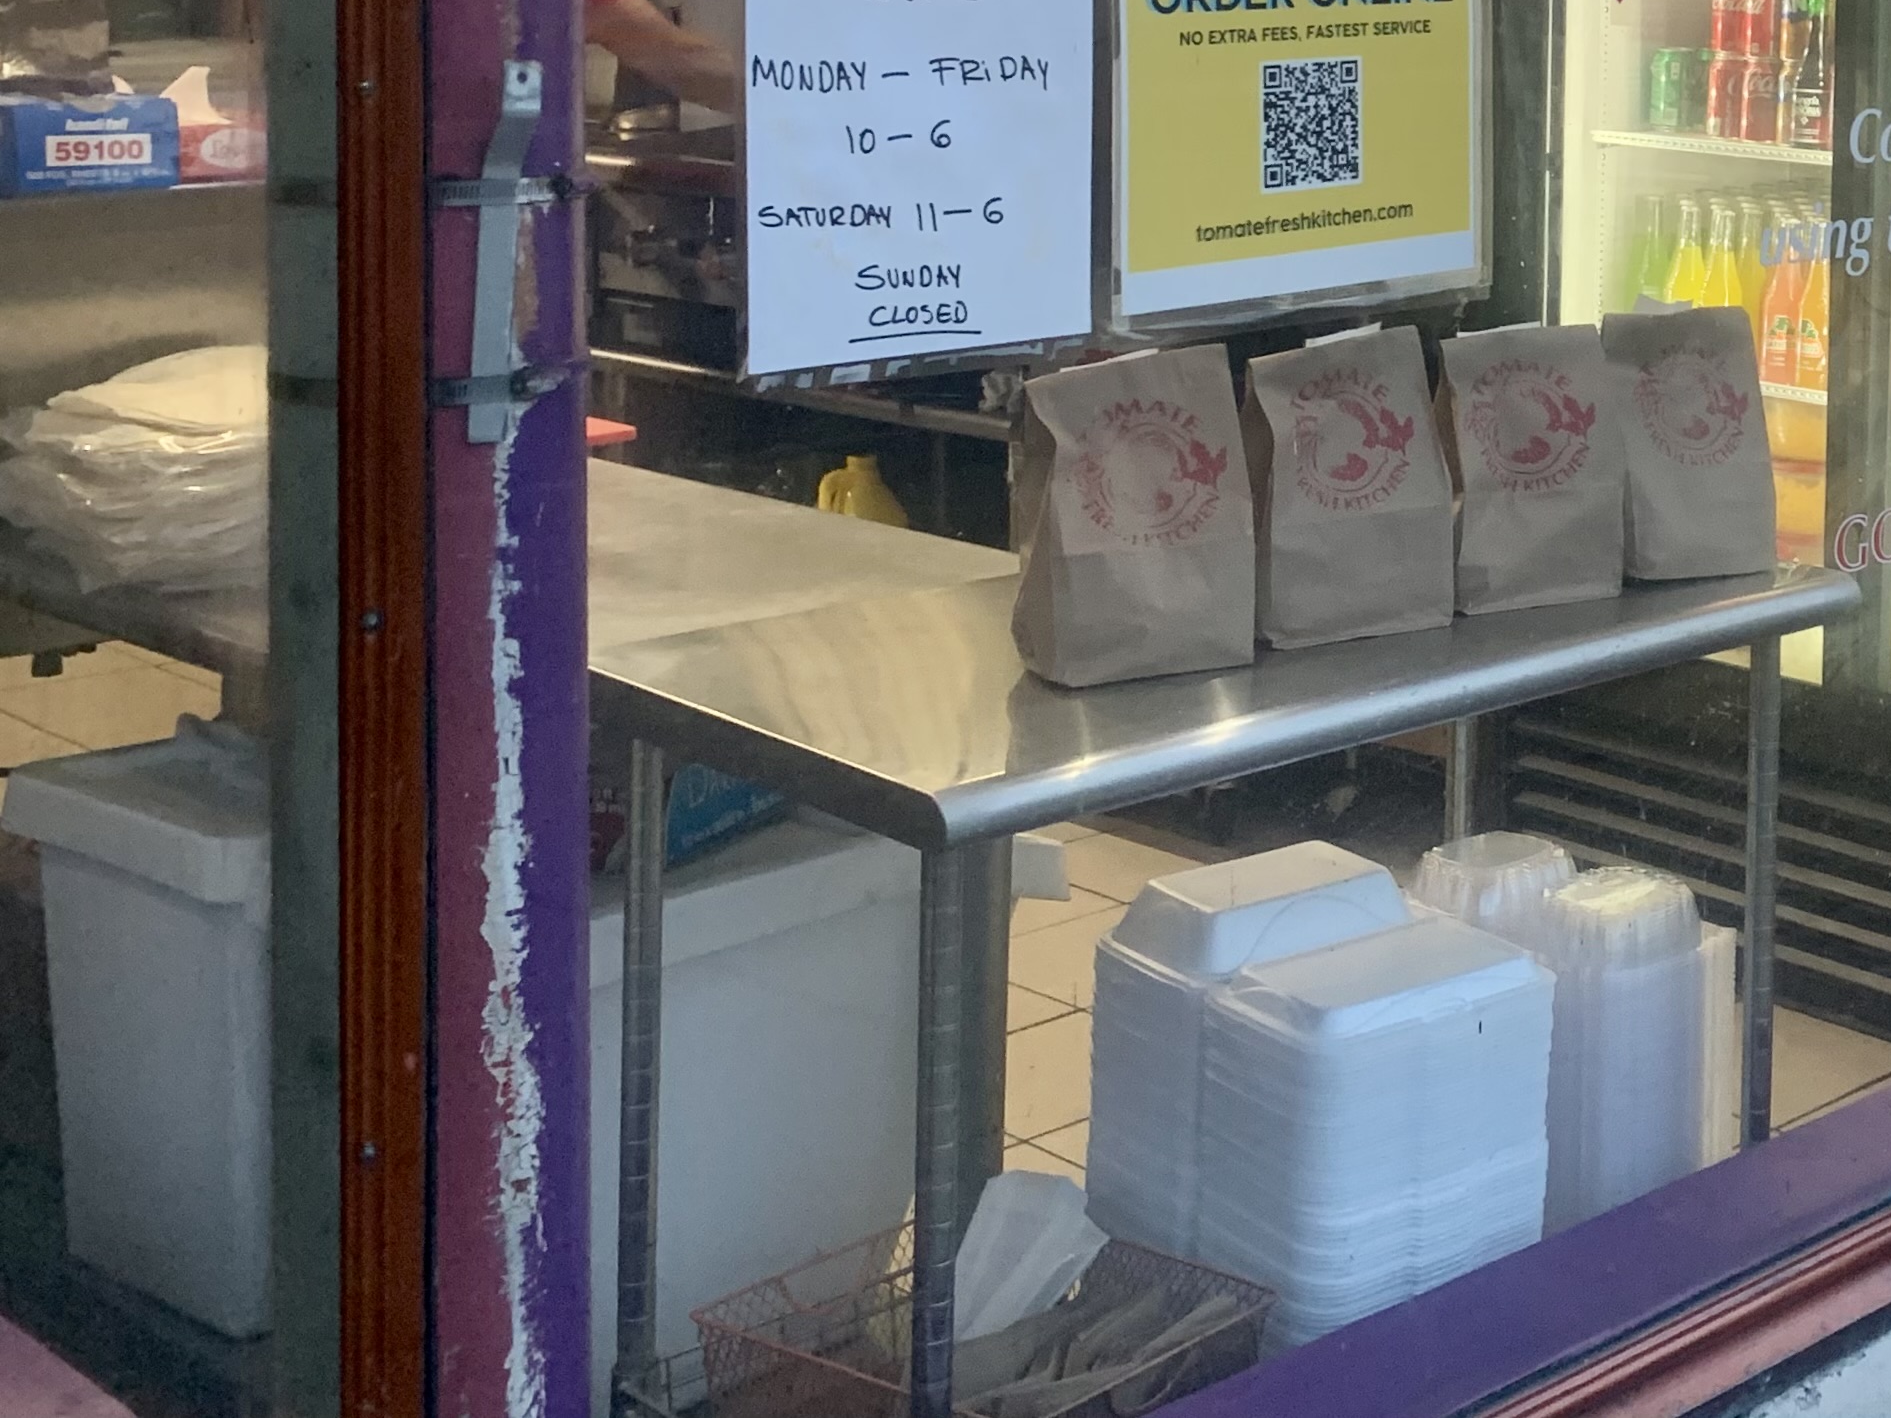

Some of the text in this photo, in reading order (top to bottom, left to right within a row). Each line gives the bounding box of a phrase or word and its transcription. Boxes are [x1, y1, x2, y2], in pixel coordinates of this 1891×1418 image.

[1179, 19, 1432, 46] NO EXTRA FEES, FASTEST SERVICE
[751, 55, 869, 93] MONDAY
[55, 140, 144, 162] 59100
[758, 204, 893, 230] SATURDAY
[1196, 202, 1414, 242] tomatefreshkitchen.com
[1760, 205, 1875, 276] using
[855, 264, 962, 292] SUNDAY
[868, 303, 968, 329] CLOSED
